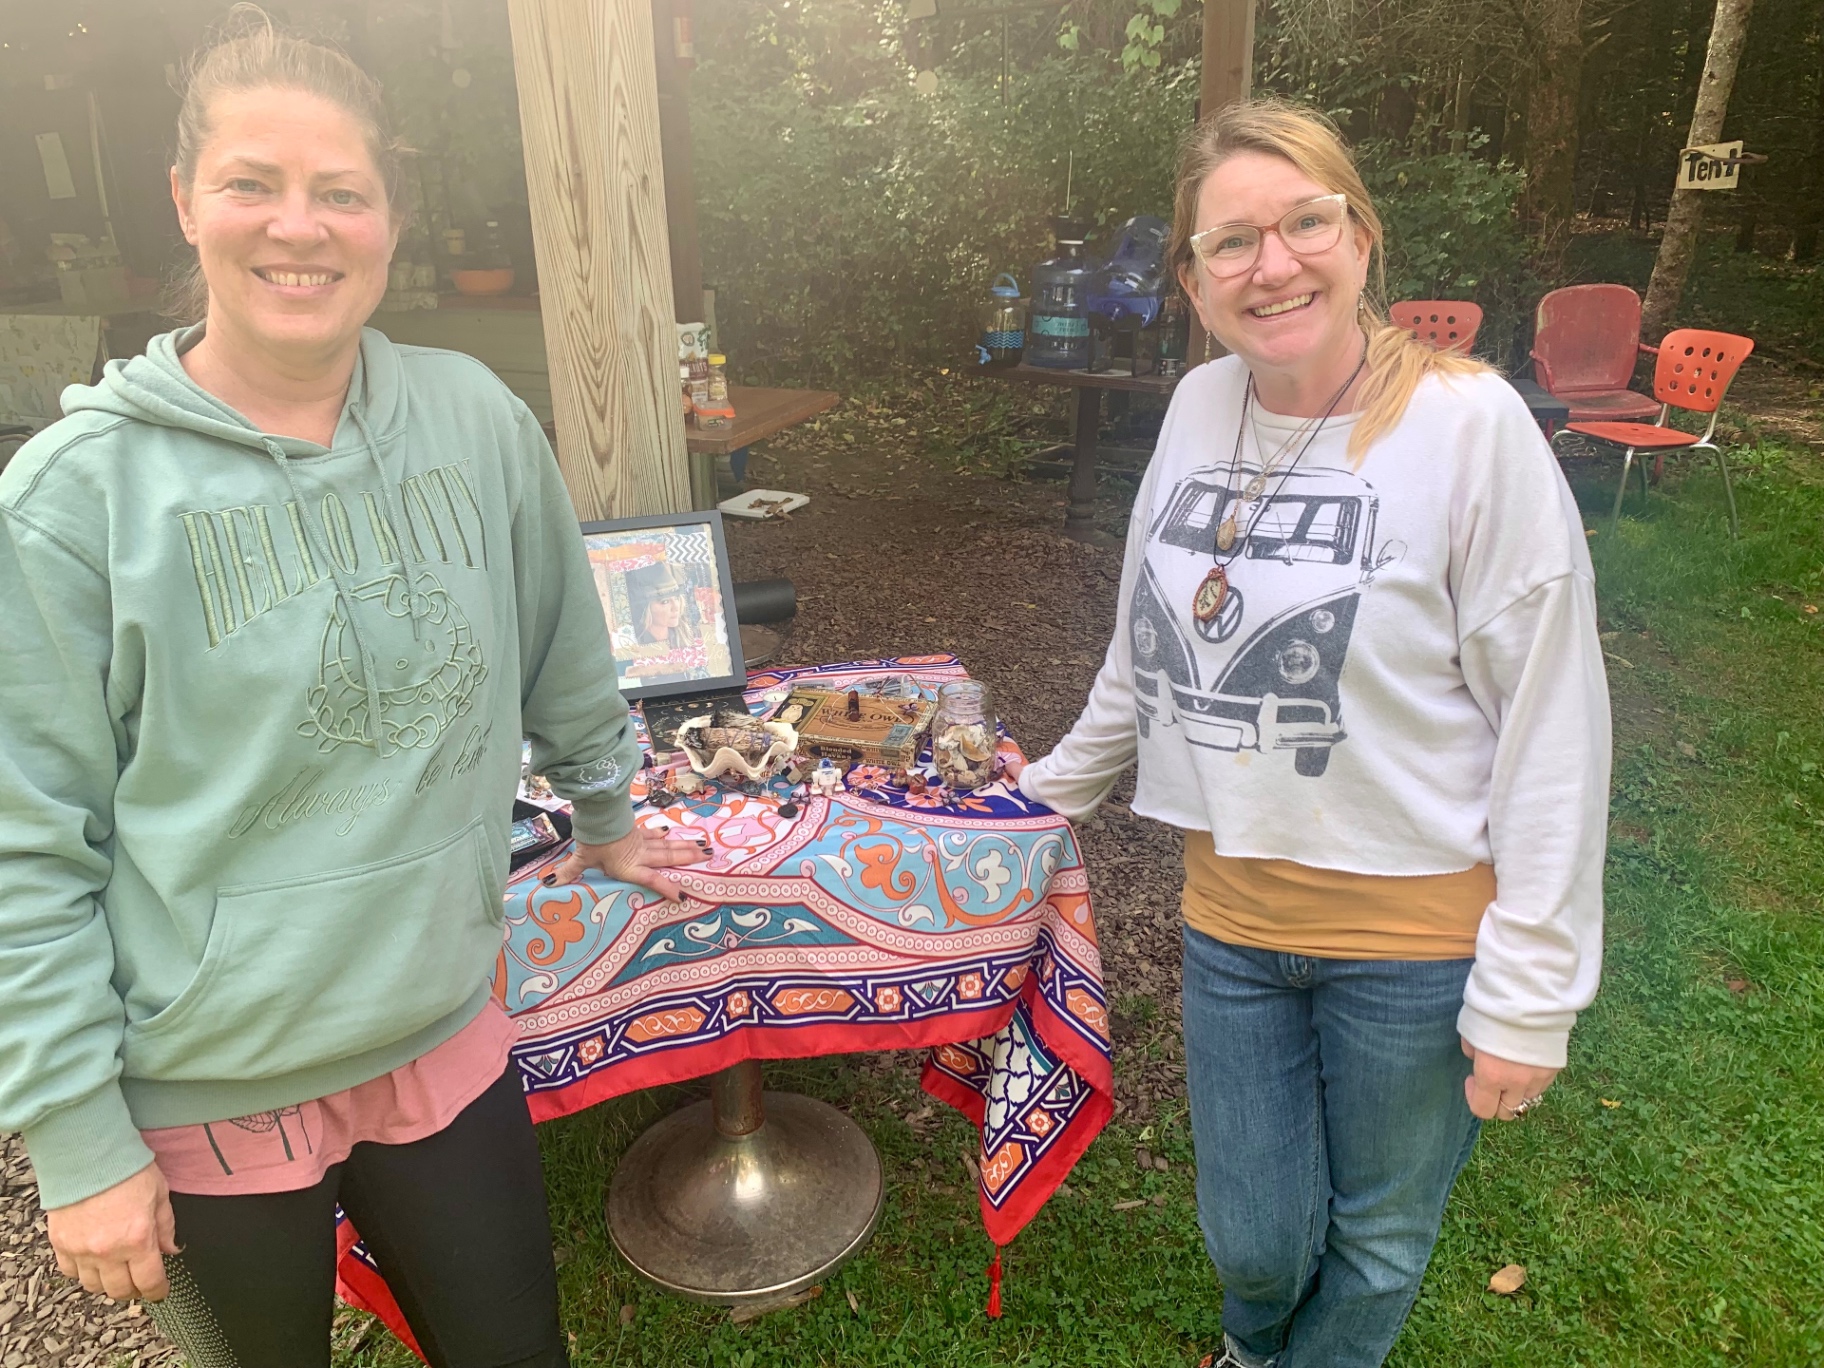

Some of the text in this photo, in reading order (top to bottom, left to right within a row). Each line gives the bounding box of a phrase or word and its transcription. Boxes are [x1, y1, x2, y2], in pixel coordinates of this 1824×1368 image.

[1685, 148, 1738, 182] Tent
[177, 458, 488, 653] HELLO KITTY
[821, 708, 903, 723] WHIE OWL
[228, 764, 391, 838] Always
[415, 742, 446, 796] be
